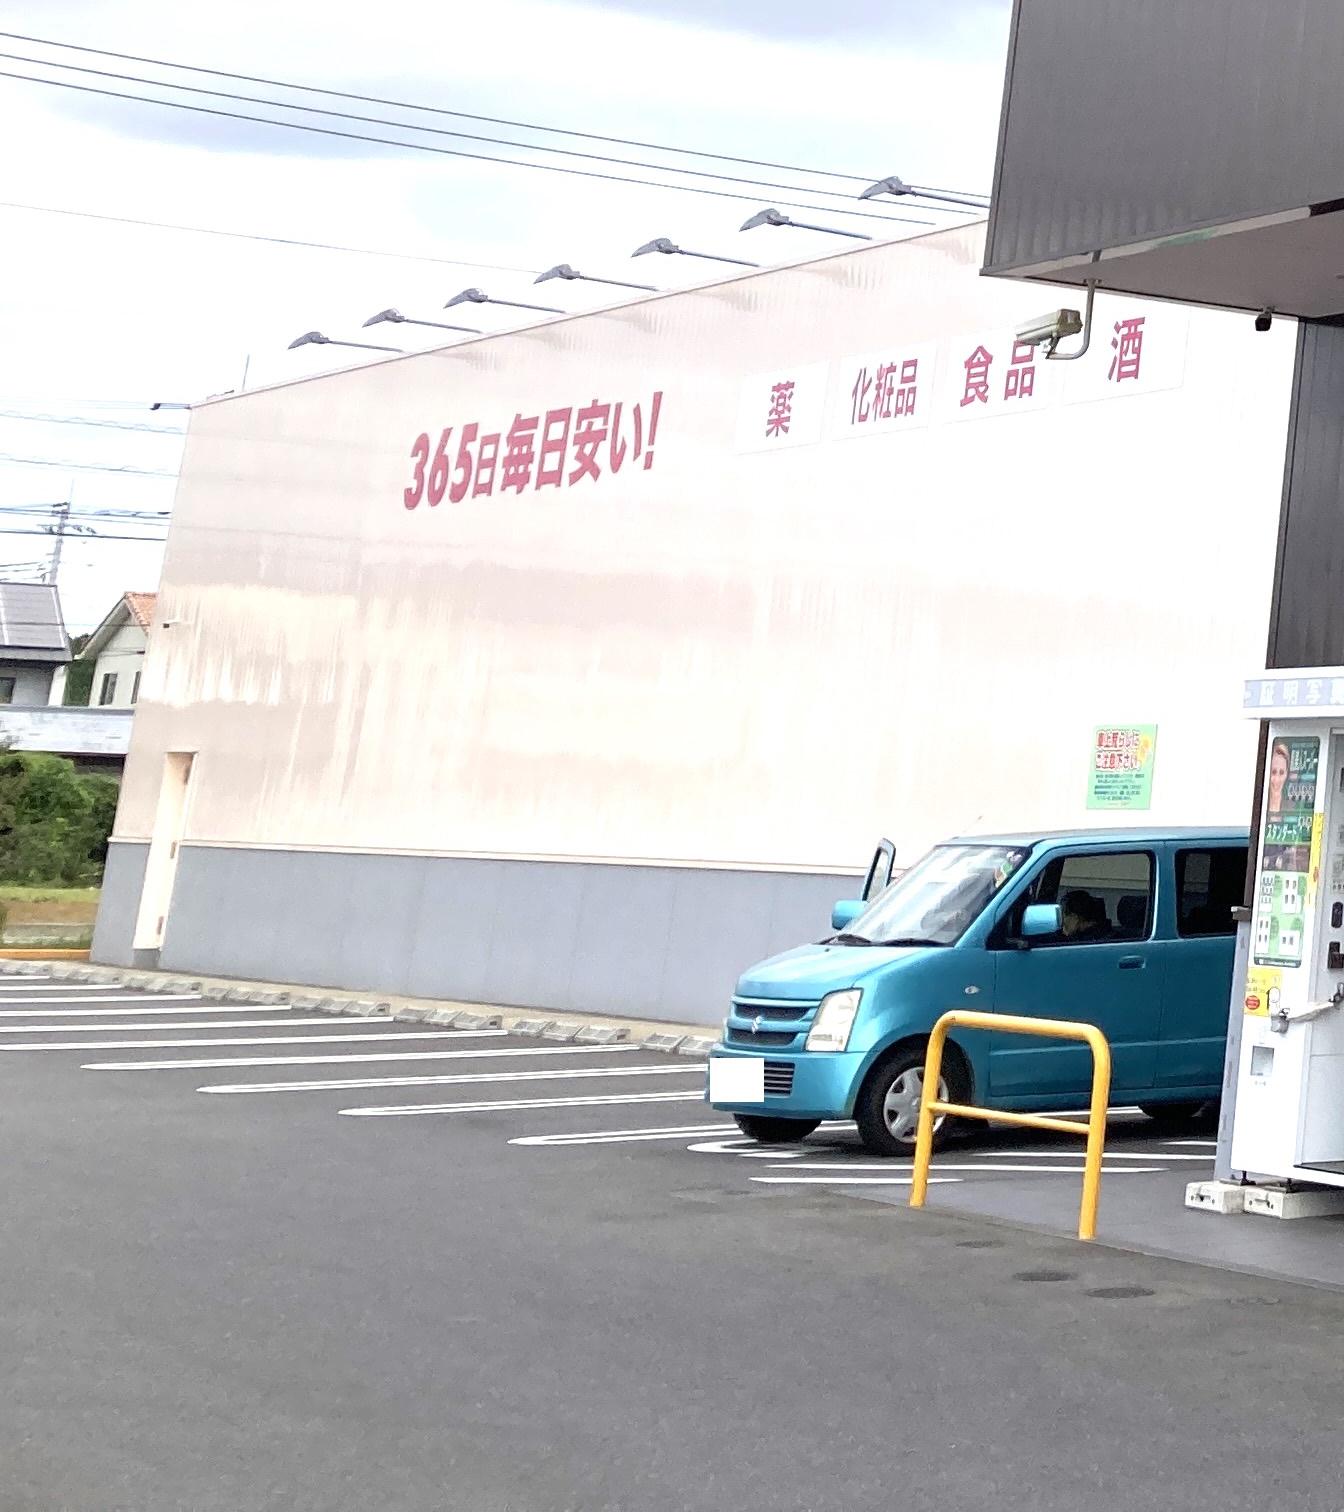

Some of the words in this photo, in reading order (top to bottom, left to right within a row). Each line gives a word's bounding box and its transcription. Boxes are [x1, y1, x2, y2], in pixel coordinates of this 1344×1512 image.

[960, 340, 1036, 410] 食品
[1107, 315, 1147, 384] 酒
[763, 380, 796, 440] 薬
[850, 357, 918, 427] 化粧品
[402, 389, 665, 512] 365日毎日安い!
